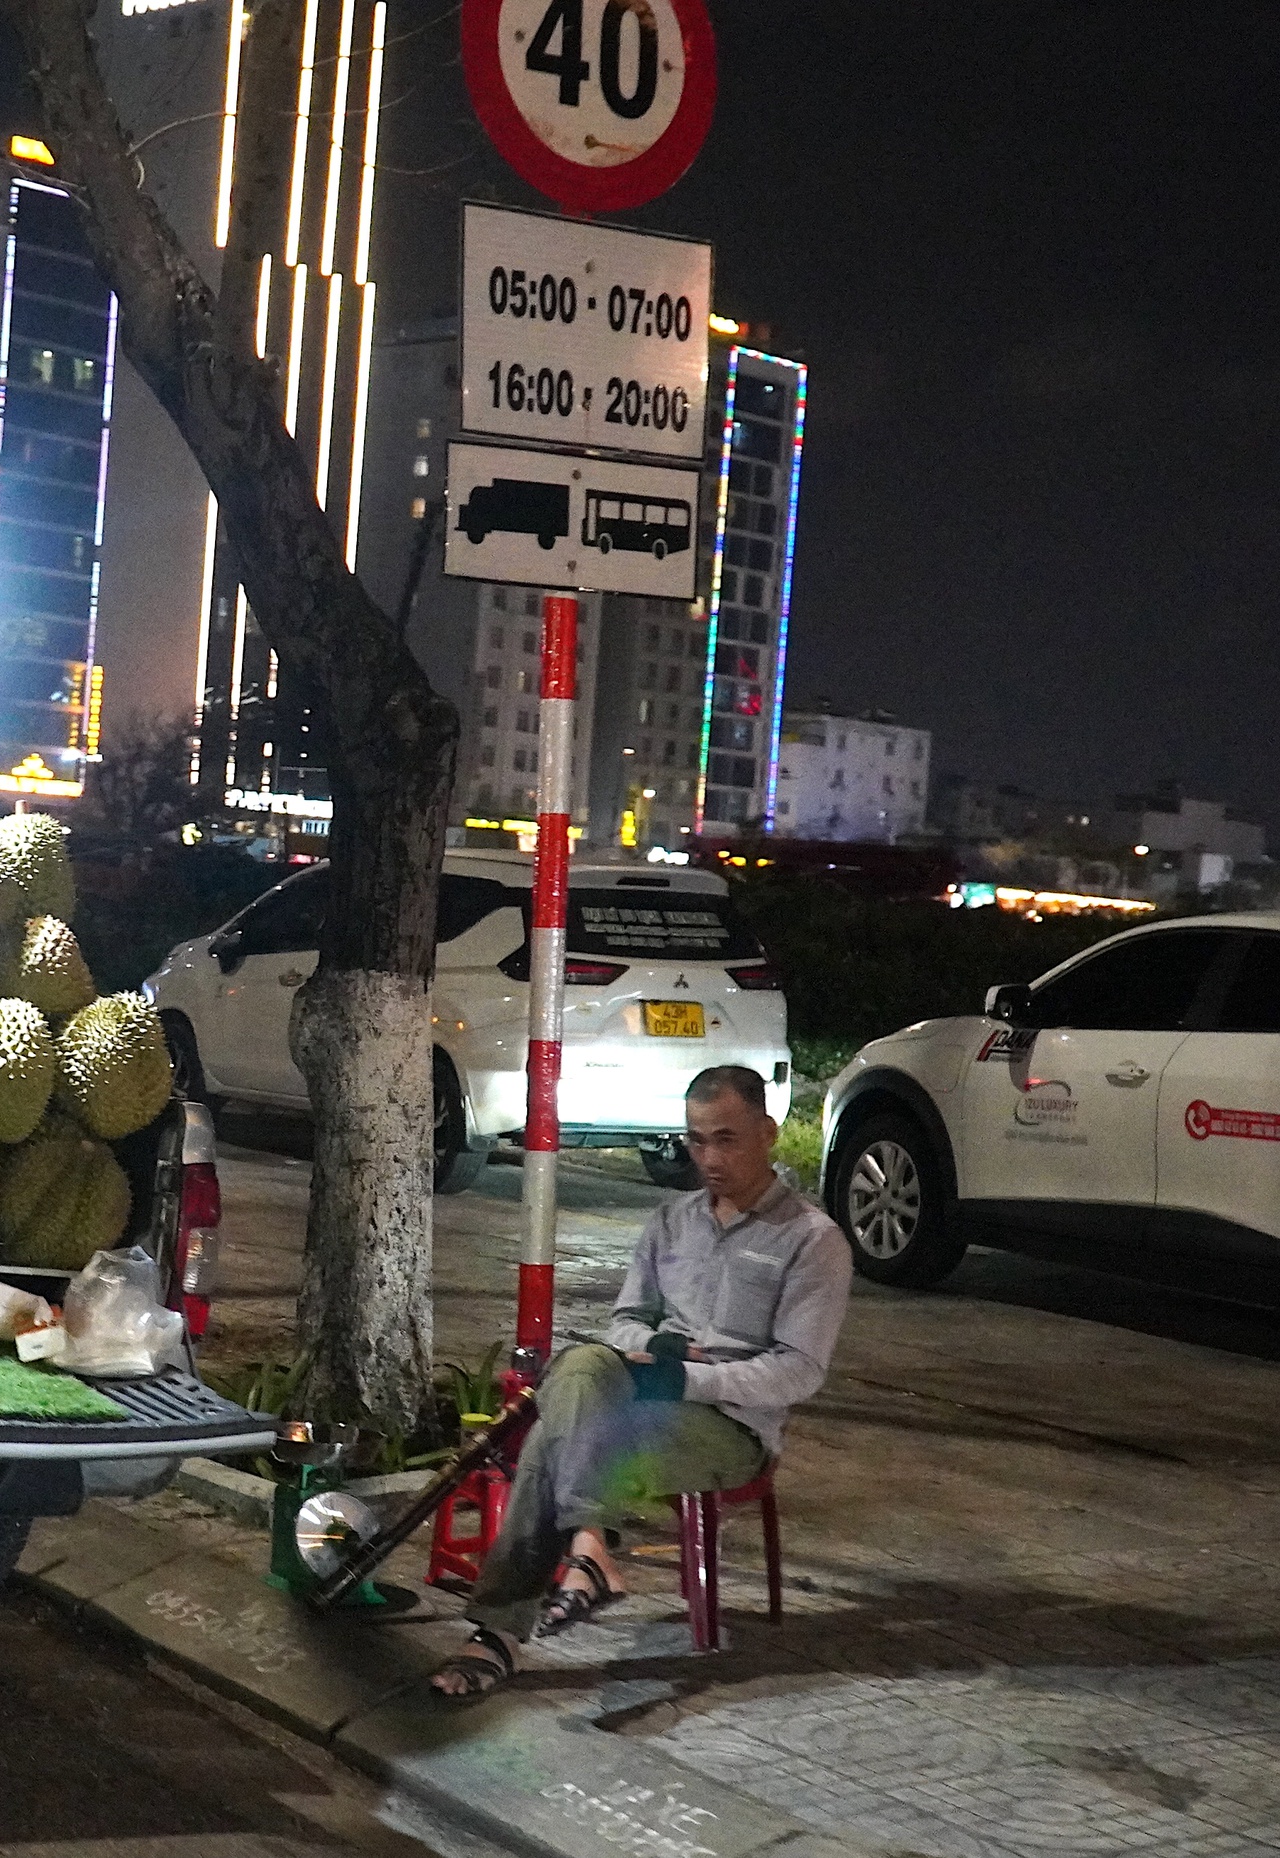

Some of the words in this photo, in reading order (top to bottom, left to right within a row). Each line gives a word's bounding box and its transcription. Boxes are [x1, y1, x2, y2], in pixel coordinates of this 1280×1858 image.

[526, 0, 658, 119] 40
[489, 266, 576, 323] 05:00
[608, 285, 691, 341] 07:00
[488, 361, 573, 417] 16:00
[605, 377, 688, 432] 20:00
